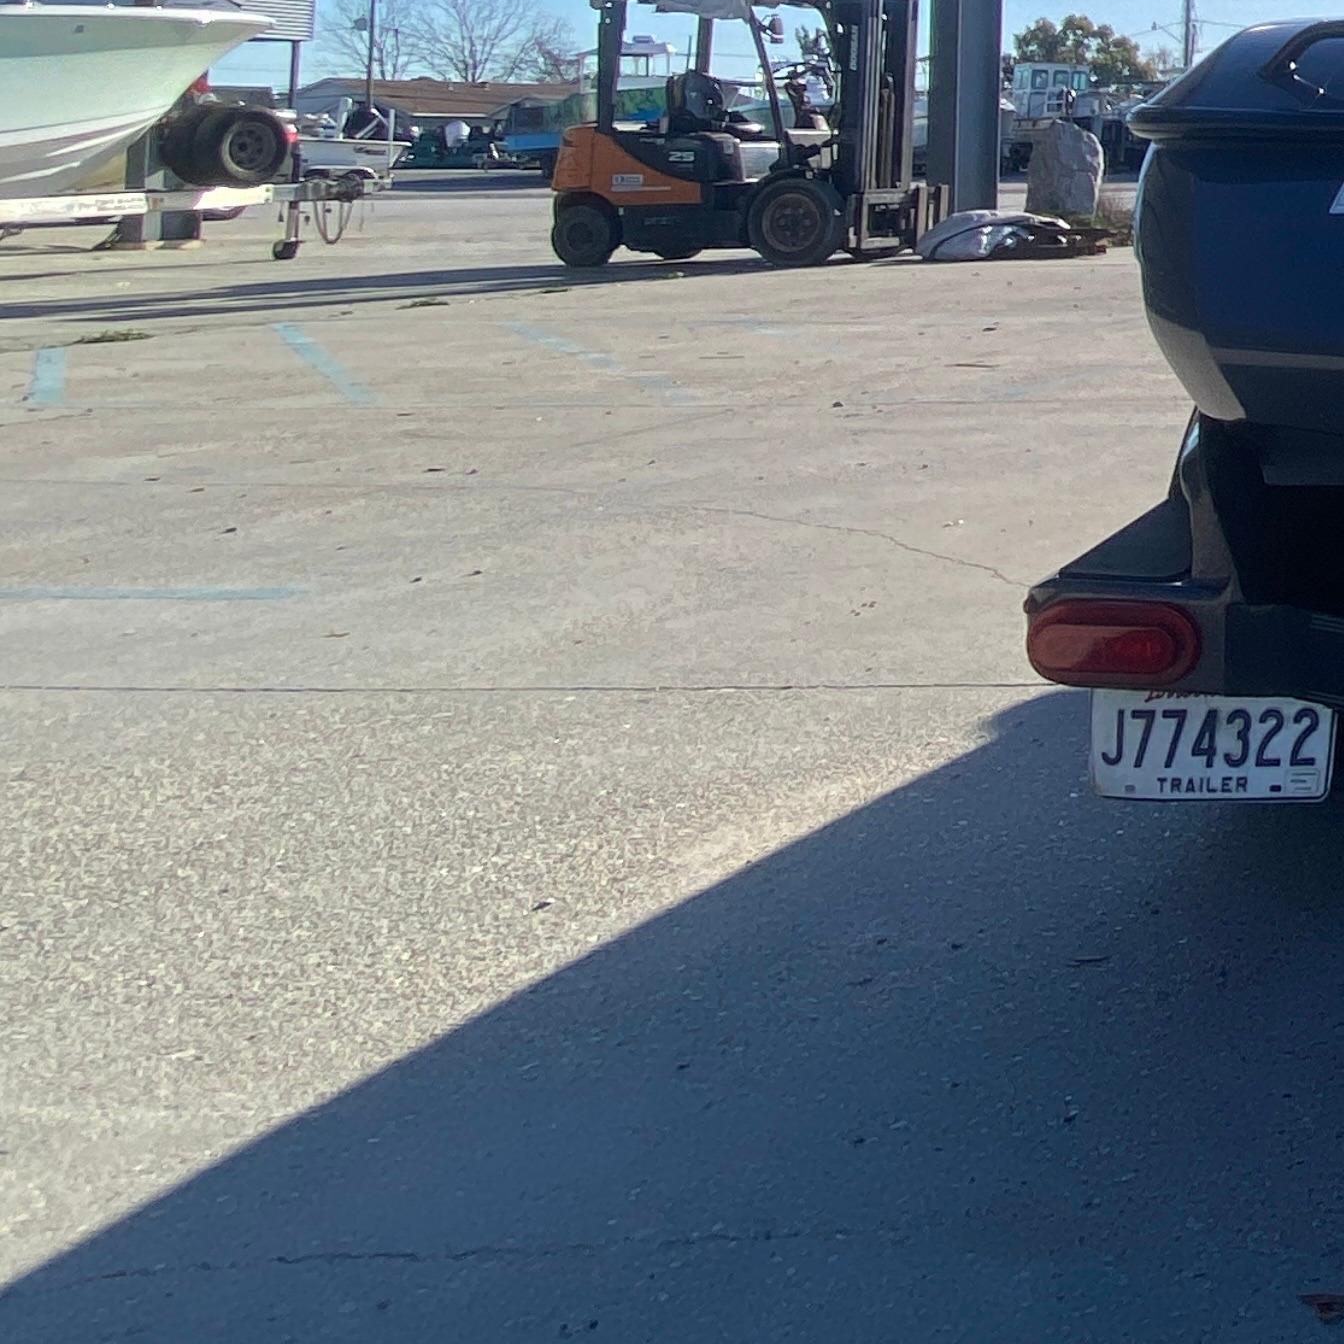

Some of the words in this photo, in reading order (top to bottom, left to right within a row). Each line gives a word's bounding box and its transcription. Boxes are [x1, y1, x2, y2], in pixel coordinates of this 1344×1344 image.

[668, 151, 694, 162] 25
[1101, 708, 1320, 769] J774322
[1156, 775, 1249, 793] TRAILER
